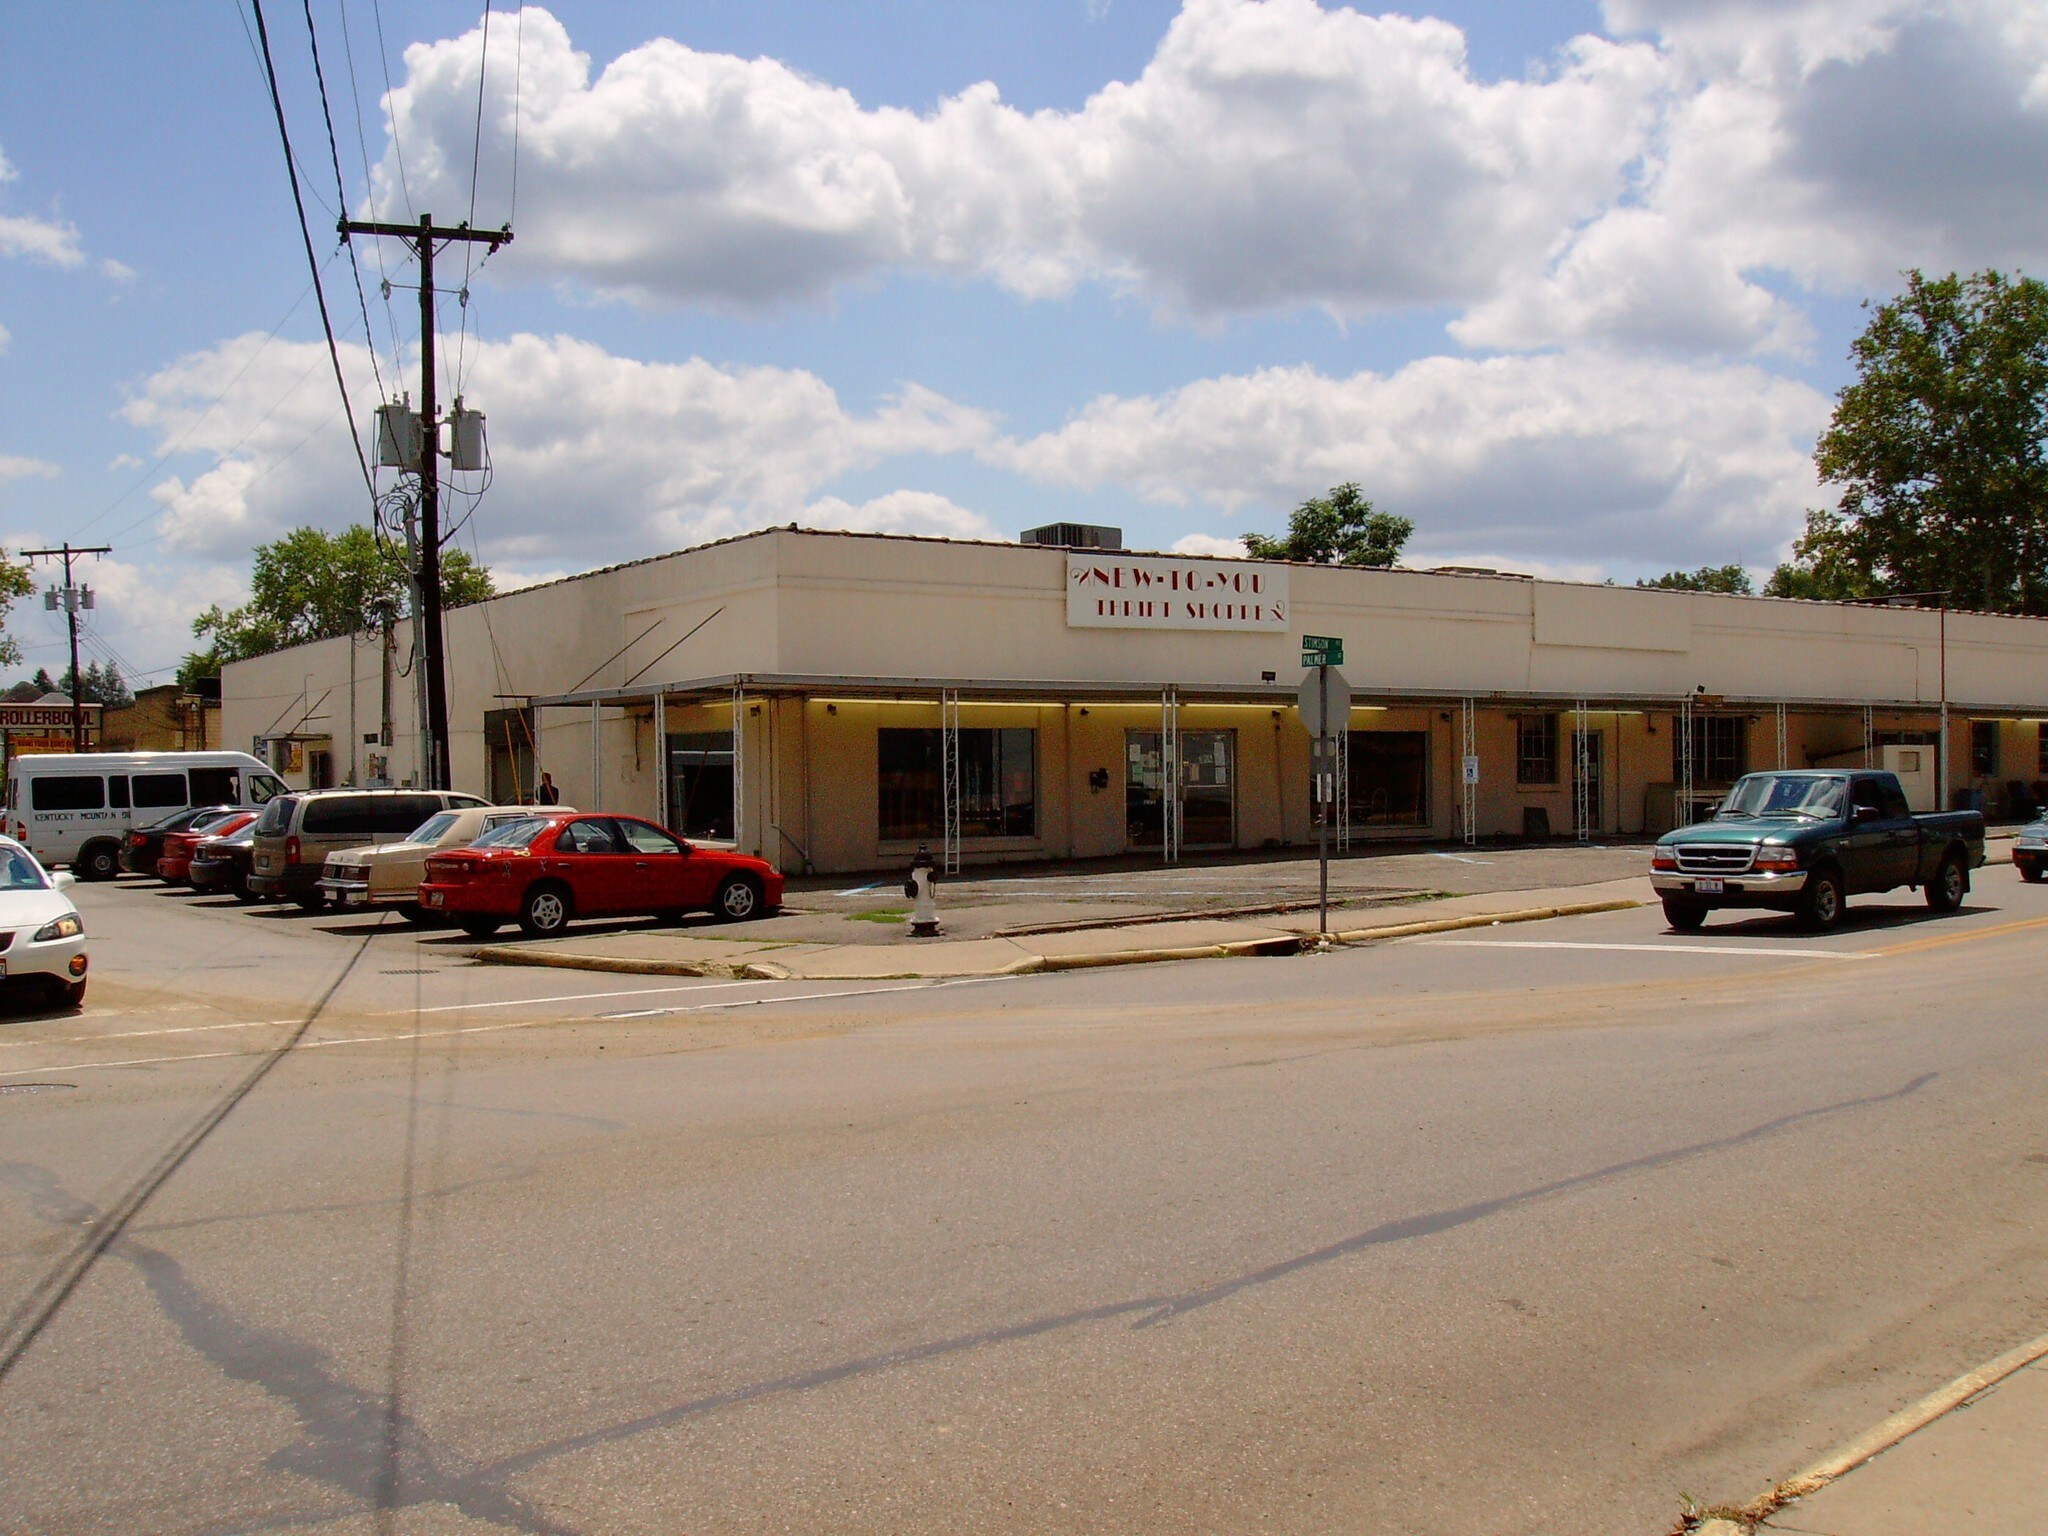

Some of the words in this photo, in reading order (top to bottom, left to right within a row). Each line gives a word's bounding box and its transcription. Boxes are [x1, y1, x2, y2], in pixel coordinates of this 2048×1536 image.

[1093, 567, 1266, 594] NEW-TO-YOU
[1095, 599, 1172, 618] THRIFT
[1303, 654, 1327, 666] PALMER
[35, 813, 74, 821] KENTUCKY
